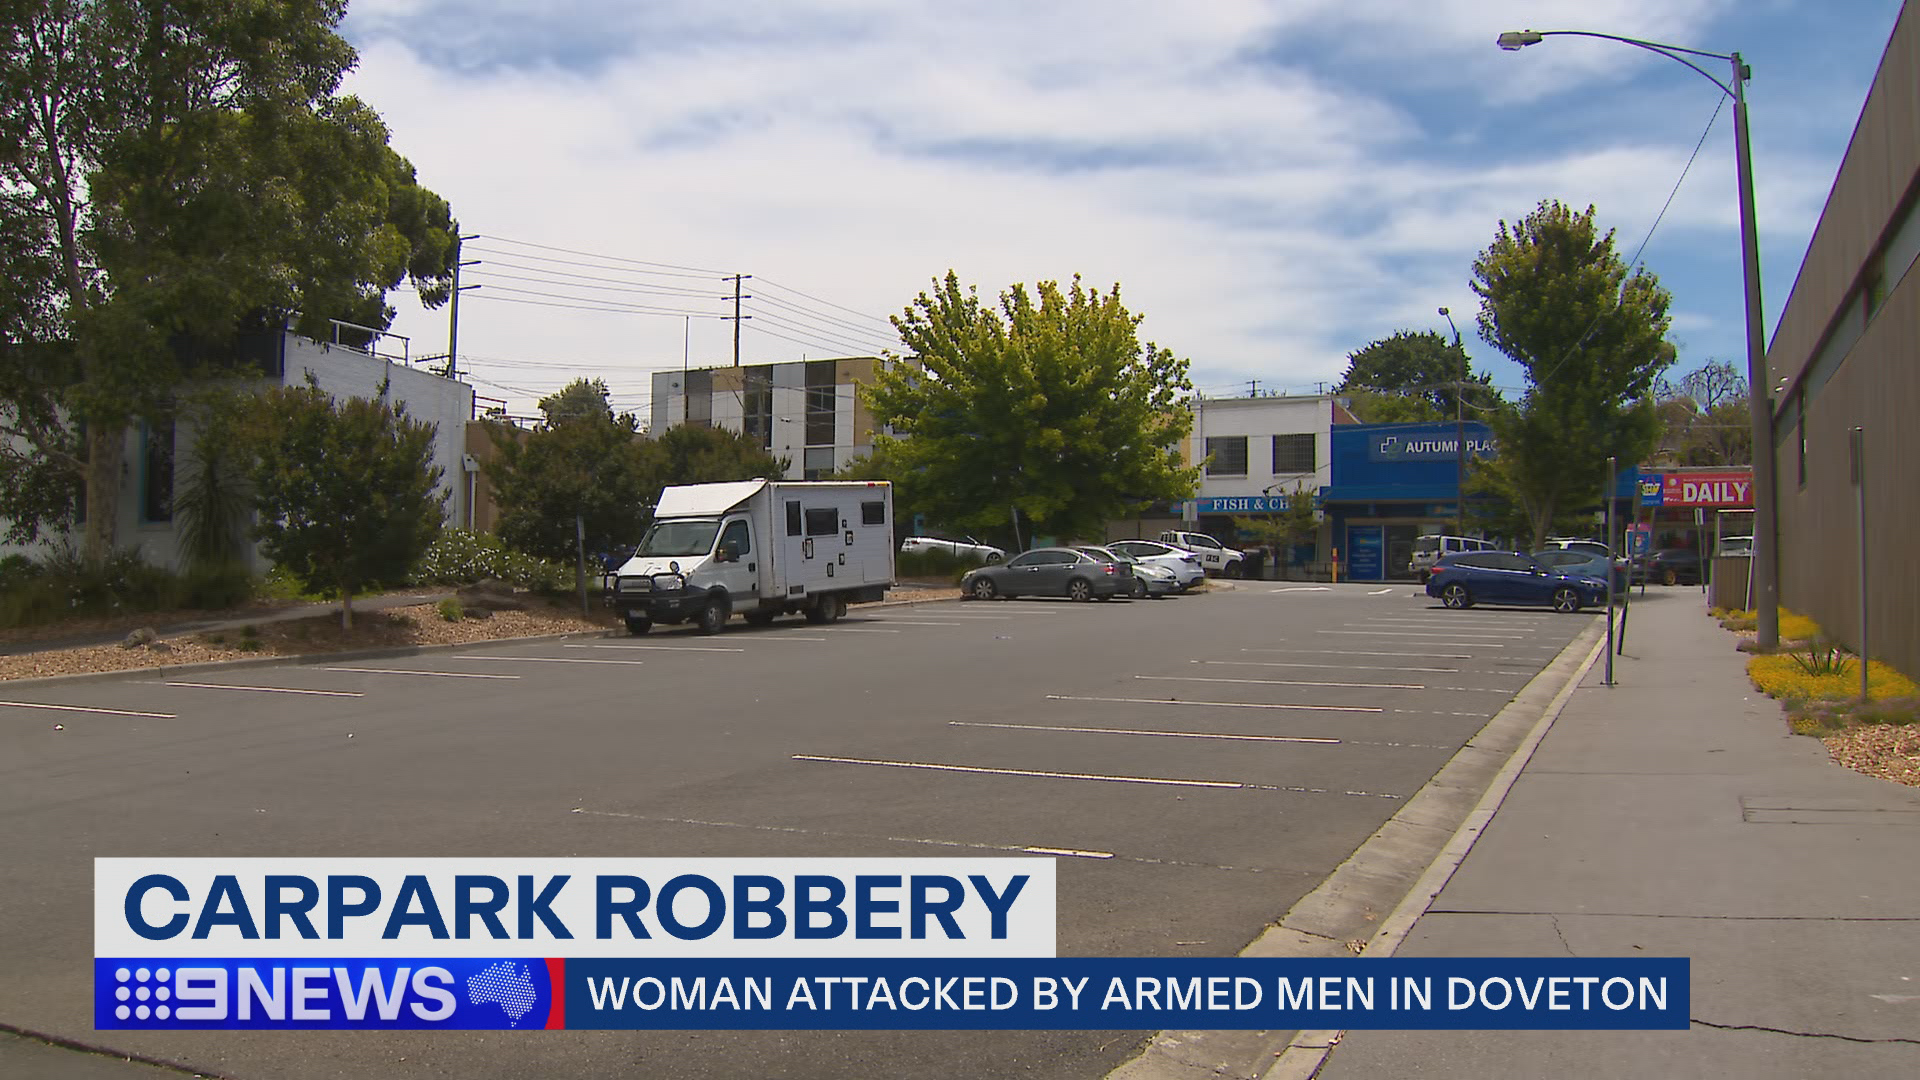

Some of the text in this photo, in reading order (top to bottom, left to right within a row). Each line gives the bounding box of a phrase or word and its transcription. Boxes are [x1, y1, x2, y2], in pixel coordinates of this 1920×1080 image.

[1466, 440, 1498, 452] PLAC
[1682, 482, 1749, 502] DAILY
[1213, 498, 1248, 510] FISH
[1254, 498, 1265, 510] &
